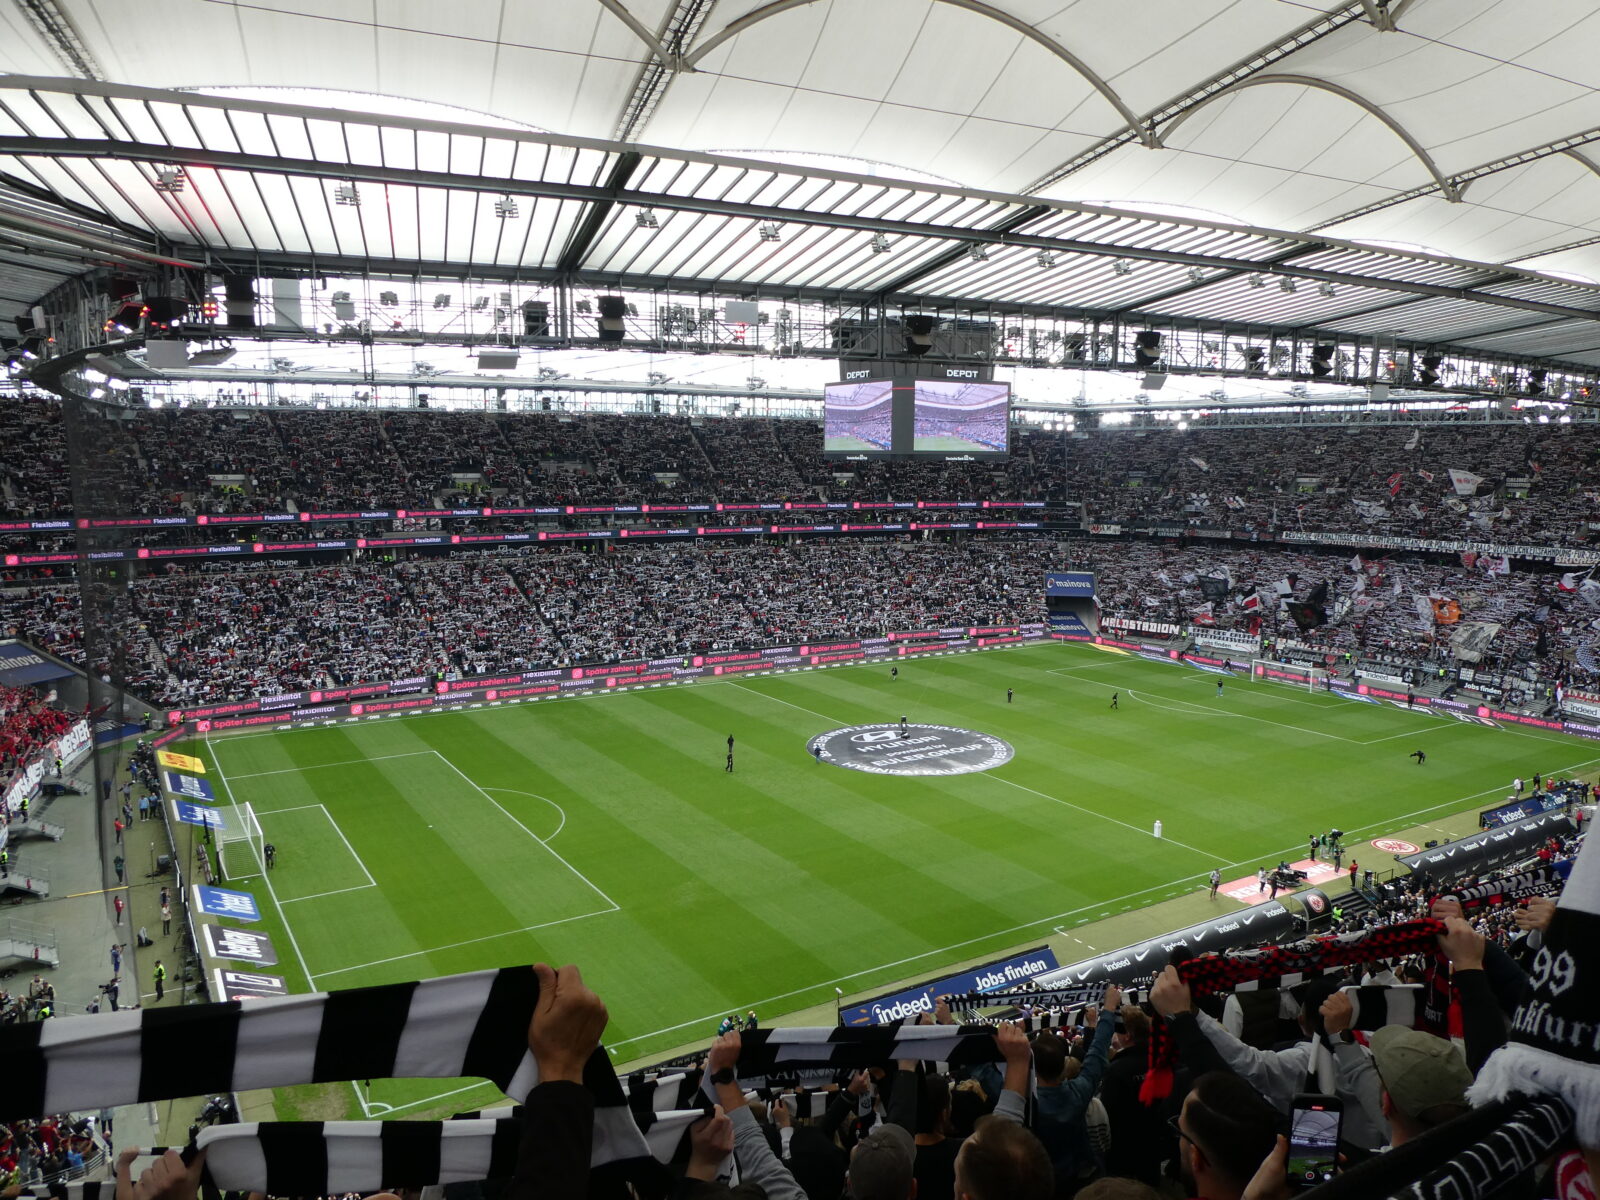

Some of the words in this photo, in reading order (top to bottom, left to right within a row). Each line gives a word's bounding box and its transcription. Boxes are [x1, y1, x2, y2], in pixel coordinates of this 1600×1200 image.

[846, 370, 870, 379] DEPOT
[946, 370, 978, 378] DEPOT
[1102, 617, 1180, 635] WALDSTADION
[1291, 659, 1312, 667] indeed
[585, 668, 610, 676] Später
[1366, 672, 1389, 681] indeed
[452, 681, 479, 690] Später
[618, 675, 639, 684] Später
[324, 690, 350, 699] Später
[350, 687, 376, 695] zahlen
[499, 689, 523, 698] Später
[1370, 688, 1393, 698] Später
[1480, 685, 1502, 695] finden
[184, 709, 214, 718] Später
[214, 705, 244, 714] zahlen
[365, 704, 392, 712] Später
[1570, 704, 1598, 716] indeed
[213, 720, 244, 728] Später
[244, 716, 274, 724] zahlen
[1491, 711, 1519, 720] Später
[1519, 717, 1547, 726] zahlen
[856, 736, 941, 752] HYUNDAI
[872, 754, 927, 767] EULER
[929, 743, 983, 758] GROUP
[886, 746, 928, 757] powered
[842, 761, 920, 775] HYUNDAI
[1498, 807, 1526, 823] indeed
[1549, 813, 1566, 821] indeed
[1521, 823, 1537, 831] indeed
[1491, 832, 1508, 841] indeed
[1460, 841, 1479, 851] indeed
[1426, 853, 1446, 863] indeed
[1508, 882, 1554, 899] 2021/22
[206, 890, 255, 914] indeed
[1263, 906, 1286, 918] indeed
[1215, 921, 1239, 934] indeed
[218, 929, 267, 958] betway
[1102, 957, 1131, 971] indeed
[1529, 945, 1576, 996] 99
[872, 993, 932, 1023] indeed
[975, 973, 1006, 991] Jobs
[1005, 959, 1047, 980] finden
